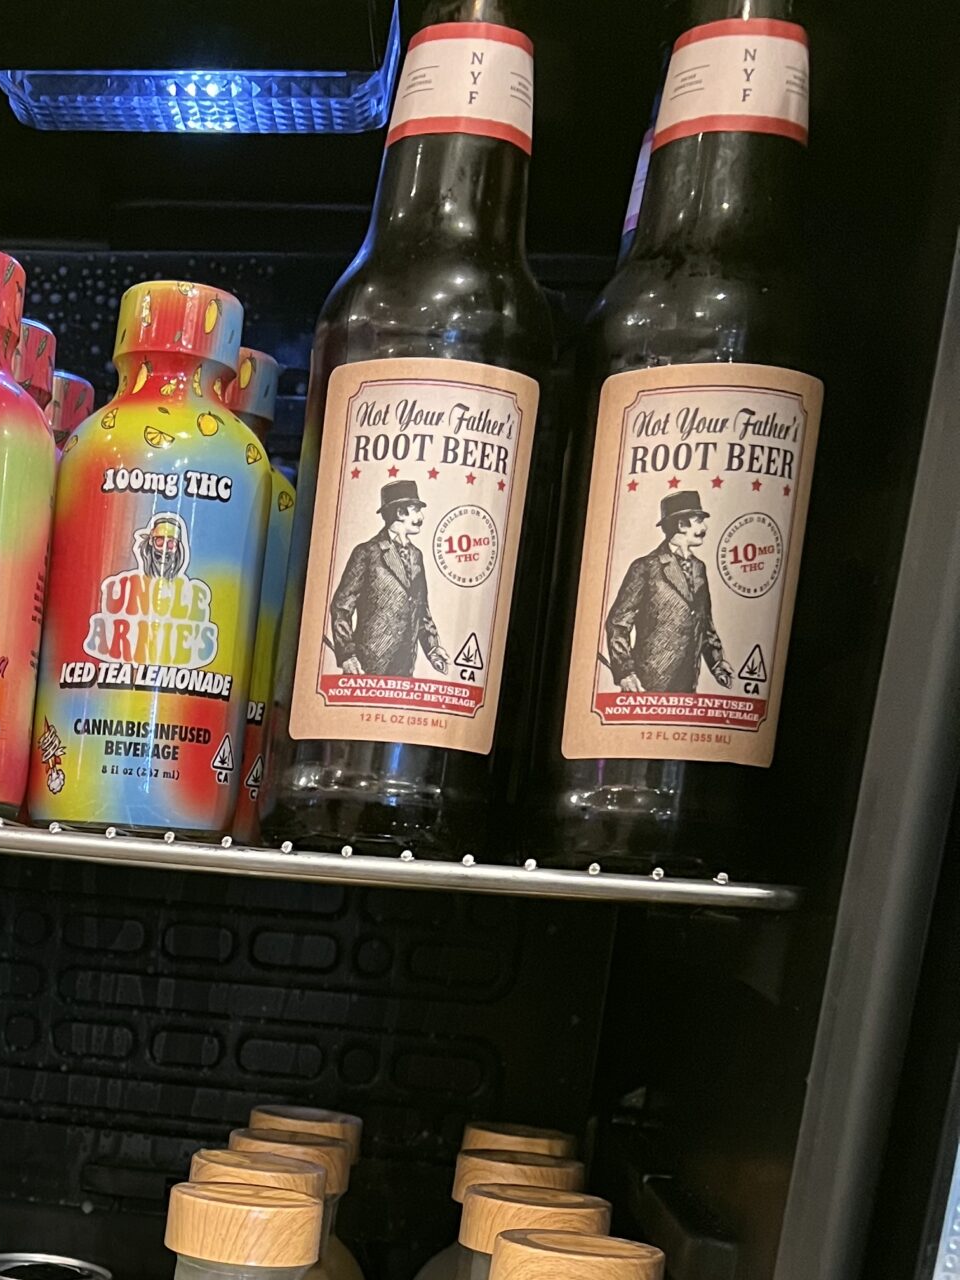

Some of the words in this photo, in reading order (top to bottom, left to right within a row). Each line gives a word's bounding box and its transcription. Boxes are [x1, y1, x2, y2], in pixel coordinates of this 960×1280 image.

[356, 400, 390, 427] Not
[395, 399, 445, 431] Your
[449, 403, 514, 439] Father's
[632, 409, 670, 437] Not
[676, 407, 729, 440] Your
[733, 407, 800, 443] Father's
[352, 434, 434, 463] ROOT
[440, 436, 509, 475] BEER
[629, 442, 717, 475] ROOT
[724, 443, 794, 480] BEER
[102, 468, 178, 500] 100mg
[185, 471, 232, 502] THC
[444, 534, 471, 554] 10
[729, 543, 757, 565] 10
[107, 575, 207, 623] UNCLE
[87, 618, 215, 665] ARNIE'S
[59, 662, 96, 688] ICED
[97, 663, 134, 690] TEA
[134, 665, 233, 702] LEMONADE
[328, 688, 353, 697] NON
[355, 689, 421, 701] ALCOHOLIC
[616, 696, 753, 711] CANNABIS-INFUSED
[632, 707, 705, 717] ALCOHOLIC
[375, 714, 387, 722] FL
[390, 715, 404, 724] OZ
[407, 715, 428, 727] (355
[431, 718, 447, 729] ML)
[656, 732, 669, 740] FL
[672, 732, 688, 741] OZ
[690, 732, 712, 743] (355
